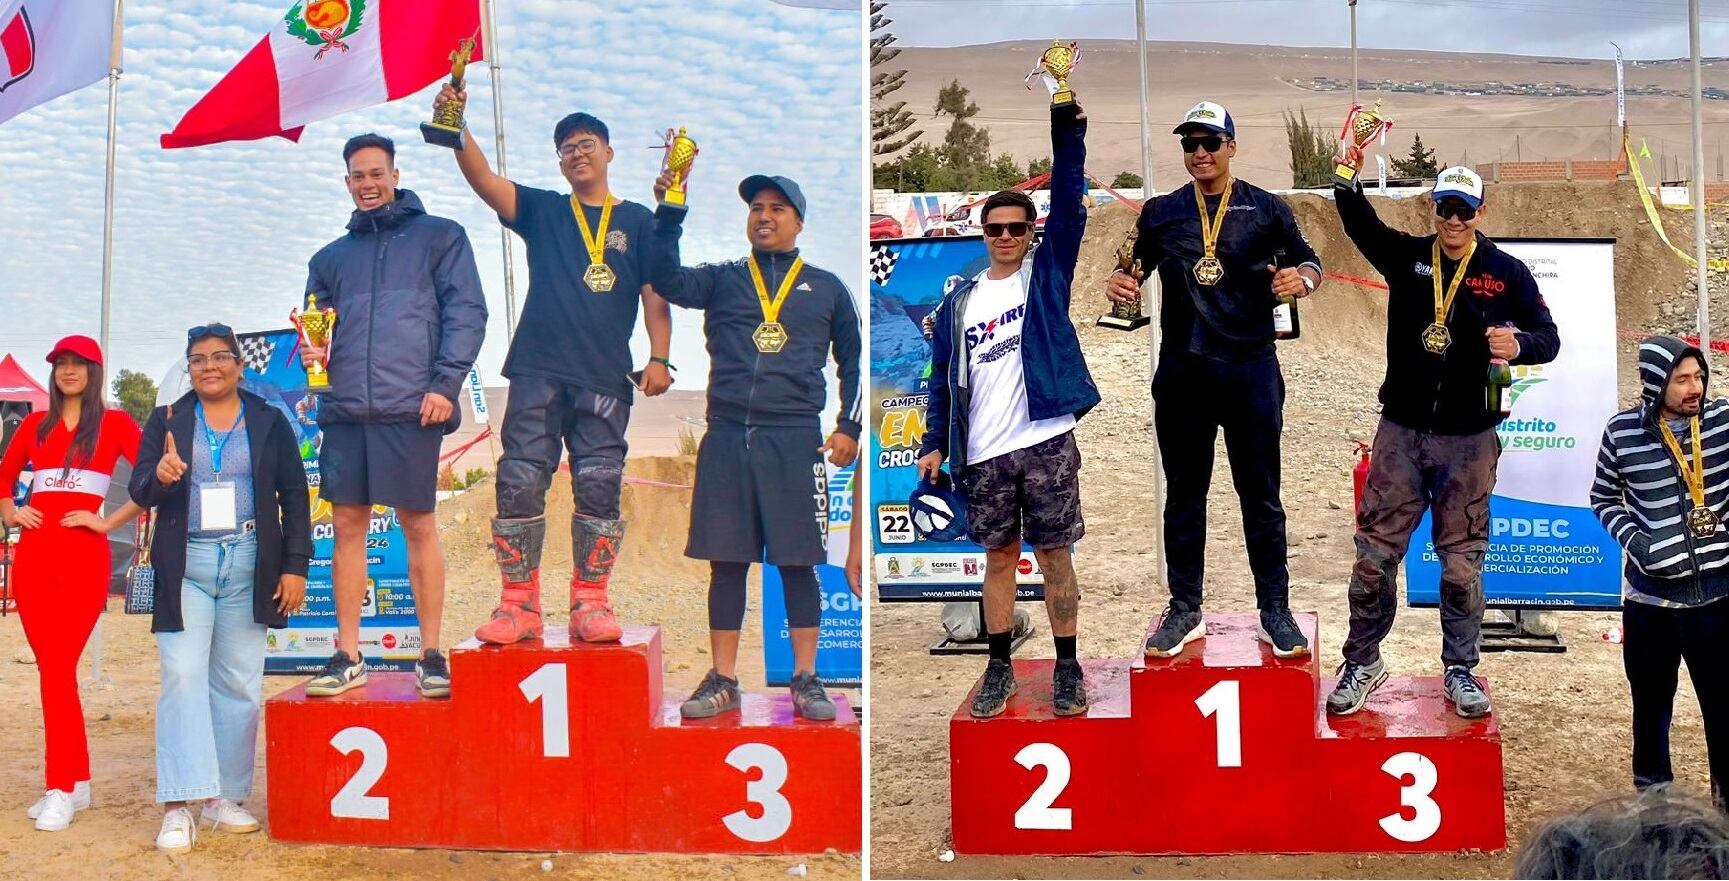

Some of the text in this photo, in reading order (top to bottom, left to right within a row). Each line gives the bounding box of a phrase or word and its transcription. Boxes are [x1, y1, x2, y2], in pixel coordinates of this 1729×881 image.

[881, 394, 929, 409] CAMPEO
[1513, 436, 1576, 451] seguro
[879, 449, 921, 468] CRO
[45, 477, 75, 489] Claro
[813, 462, 828, 551] adidas
[882, 515, 910, 532] 22
[1493, 518, 1570, 538] PDEC
[366, 538, 389, 549] 24
[1511, 543, 1526, 552] DE
[1530, 544, 1600, 555] PROMOCIÓN
[1485, 553, 1522, 563] ROLLO
[1525, 553, 1595, 564] ECONÓMICO
[1597, 556, 1604, 564] Y
[1482, 563, 1569, 575] ERCIALIZACIÓN
[518, 663, 570, 757] 1
[1194, 680, 1241, 767] 1
[330, 727, 390, 820] 2
[721, 743, 792, 842] 3
[1013, 742, 1072, 830] 2
[1378, 751, 1442, 842] 3
